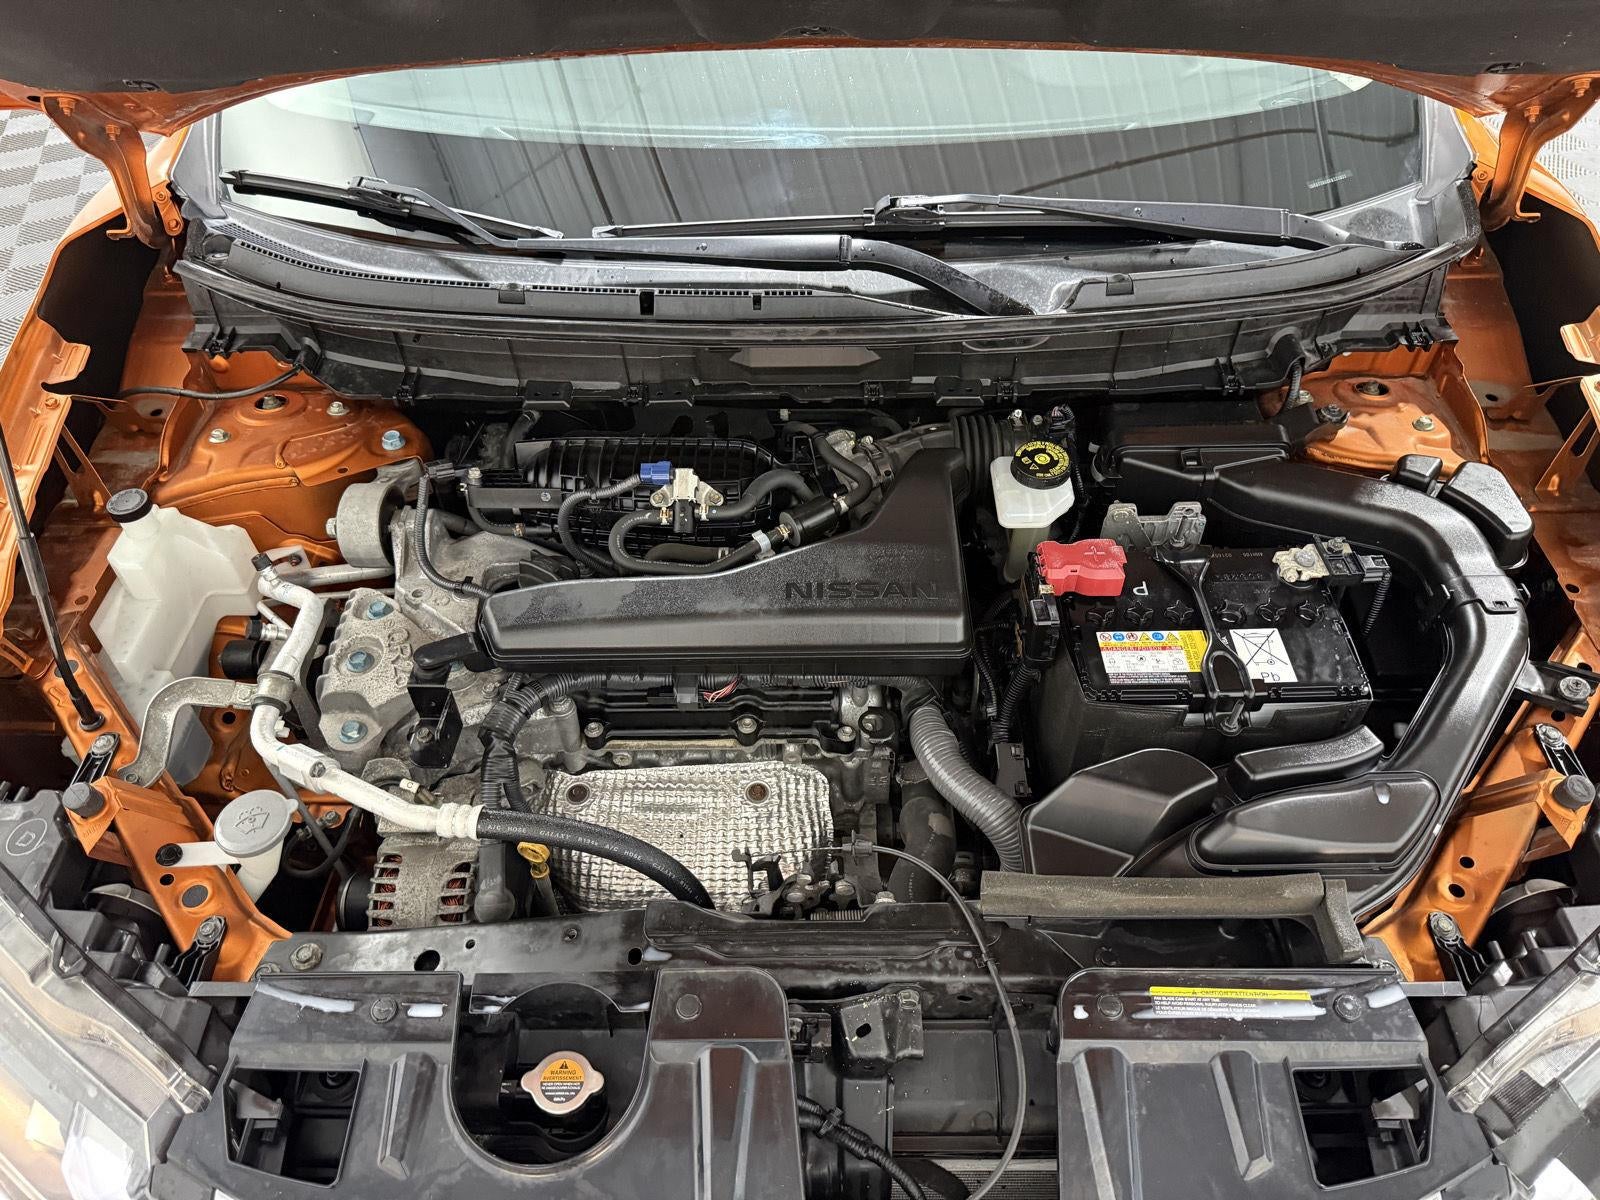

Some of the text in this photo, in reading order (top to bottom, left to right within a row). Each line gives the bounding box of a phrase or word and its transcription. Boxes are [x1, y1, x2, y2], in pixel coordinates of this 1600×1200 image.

[786, 580, 939, 600] NISSAN
[1260, 671, 1281, 682] Pb
[487, 824, 502, 832] A/C
[507, 826, 527, 834] HOSE
[539, 829, 572, 841] GALAXY
[604, 843, 619, 853] A/C
[623, 849, 643, 861] HOSE
[651, 861, 677, 880] GALAXY
